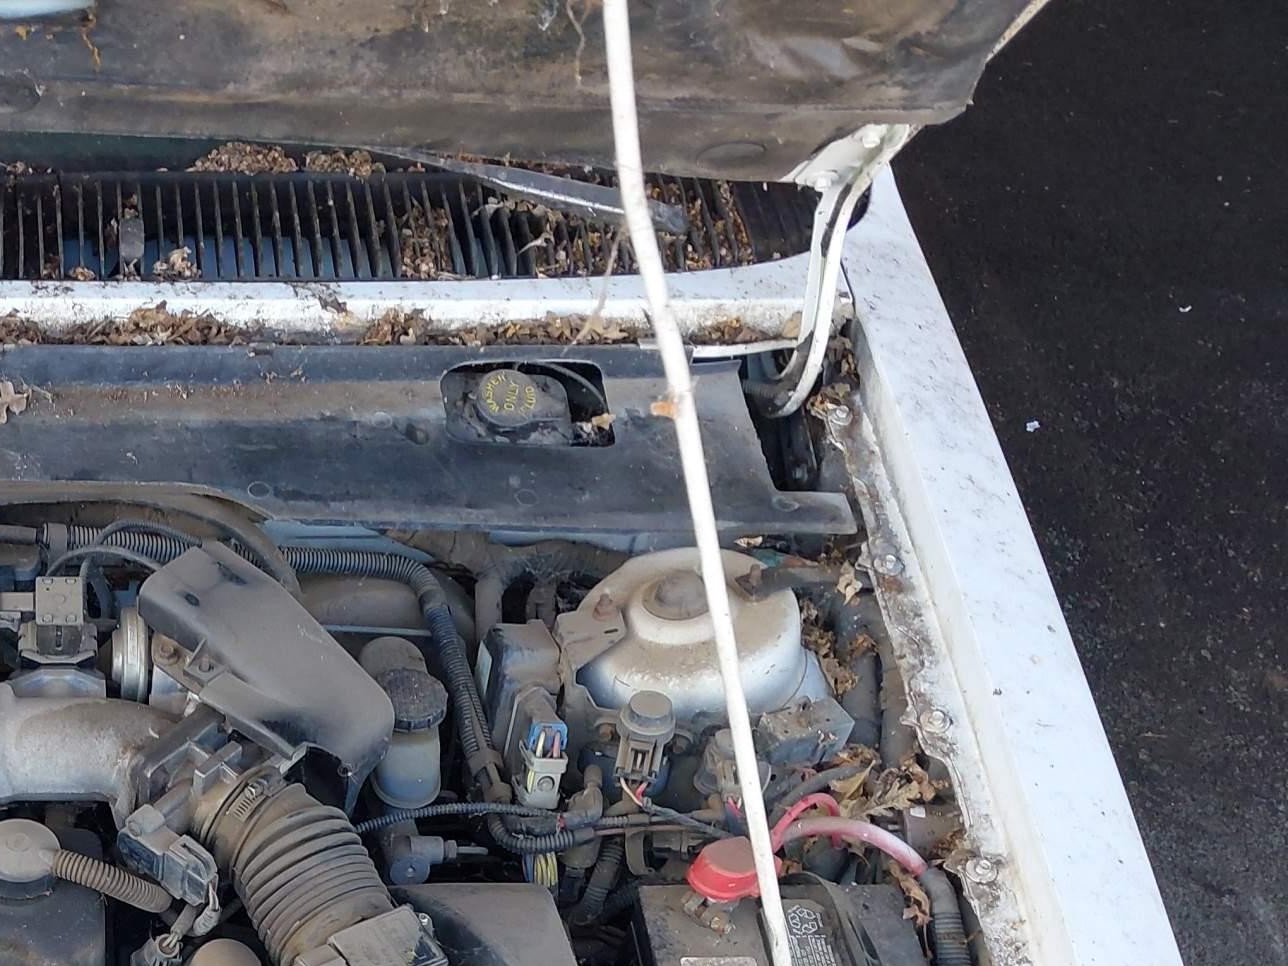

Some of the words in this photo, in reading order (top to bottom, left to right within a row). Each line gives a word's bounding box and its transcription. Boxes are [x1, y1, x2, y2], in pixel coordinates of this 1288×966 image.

[485, 374, 506, 413] WASHER
[504, 381, 519, 411] ONLY
[520, 385, 537, 416] FLUID
